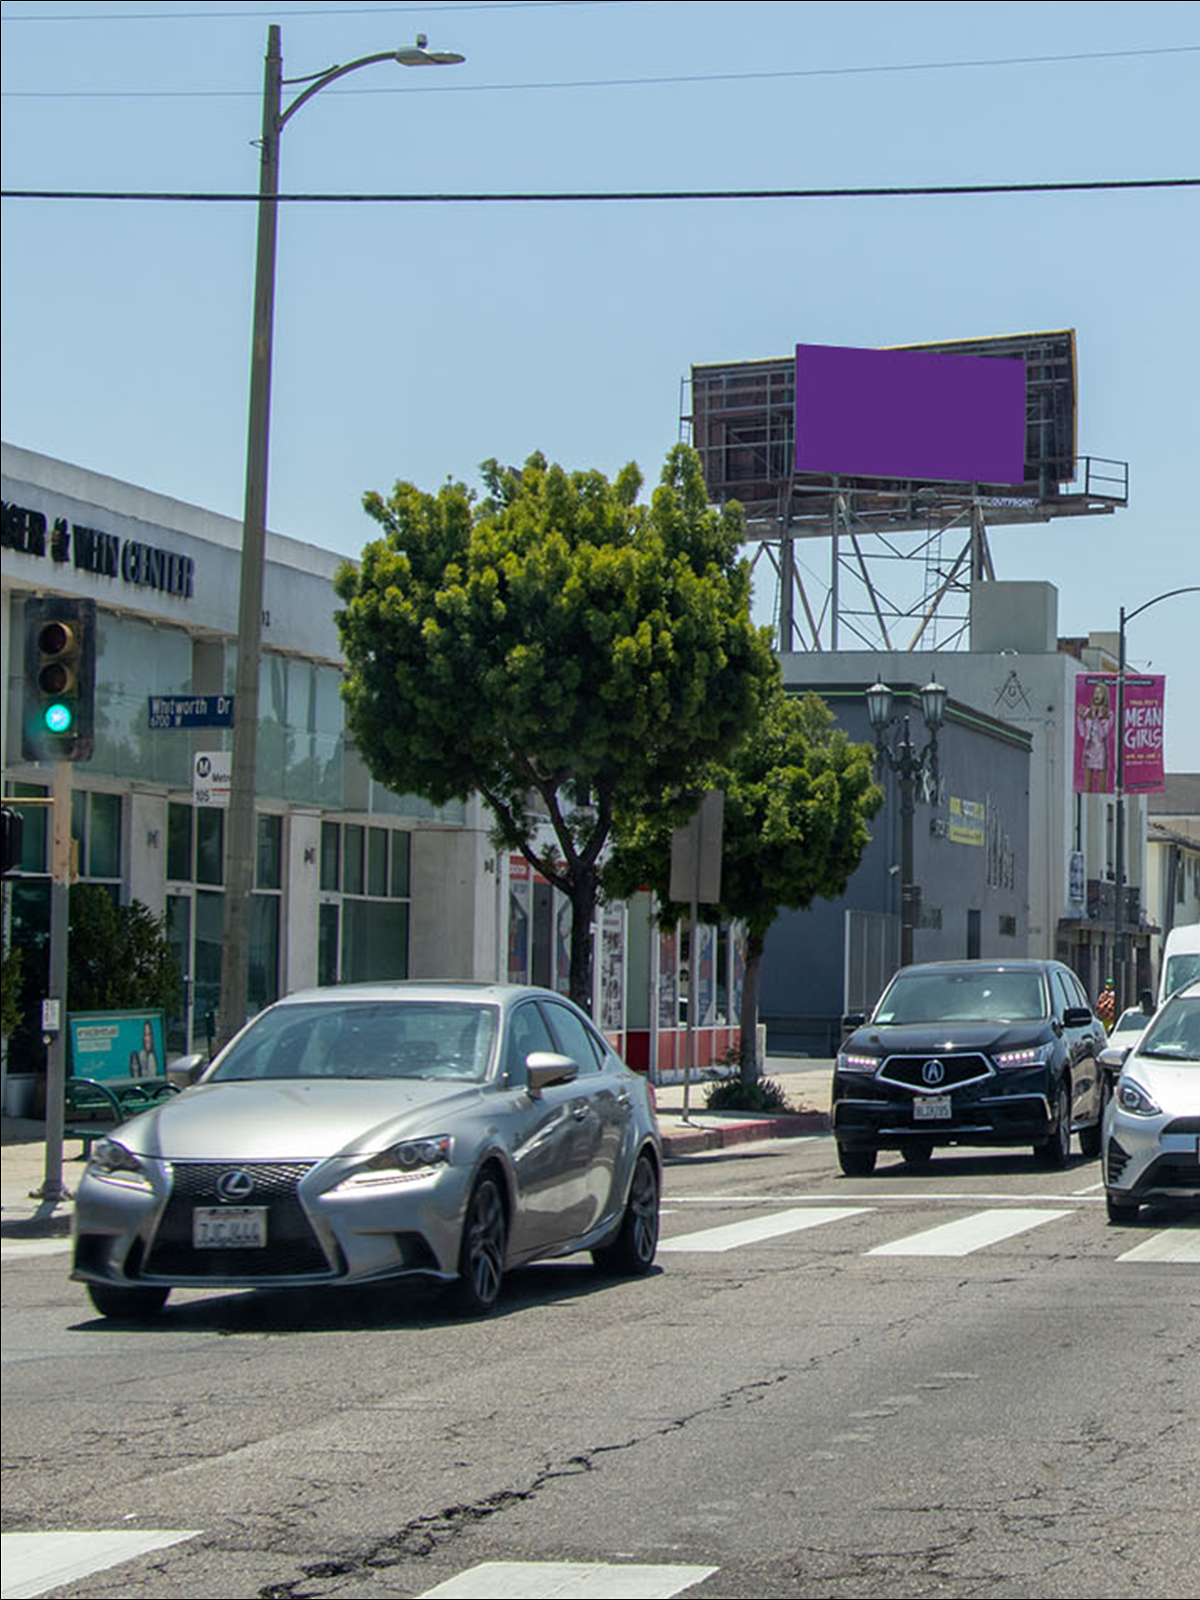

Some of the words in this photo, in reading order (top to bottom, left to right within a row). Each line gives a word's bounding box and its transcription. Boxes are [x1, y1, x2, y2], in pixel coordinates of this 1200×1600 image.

[1, 500, 47, 557] SER
[121, 539, 195, 598] CENTER
[152, 699, 207, 714] Whitworth
[217, 697, 231, 714] Dr
[150, 715, 170, 727] 6700
[1125, 707, 1162, 727] MEAN
[1124, 728, 1163, 749] GIRLS
